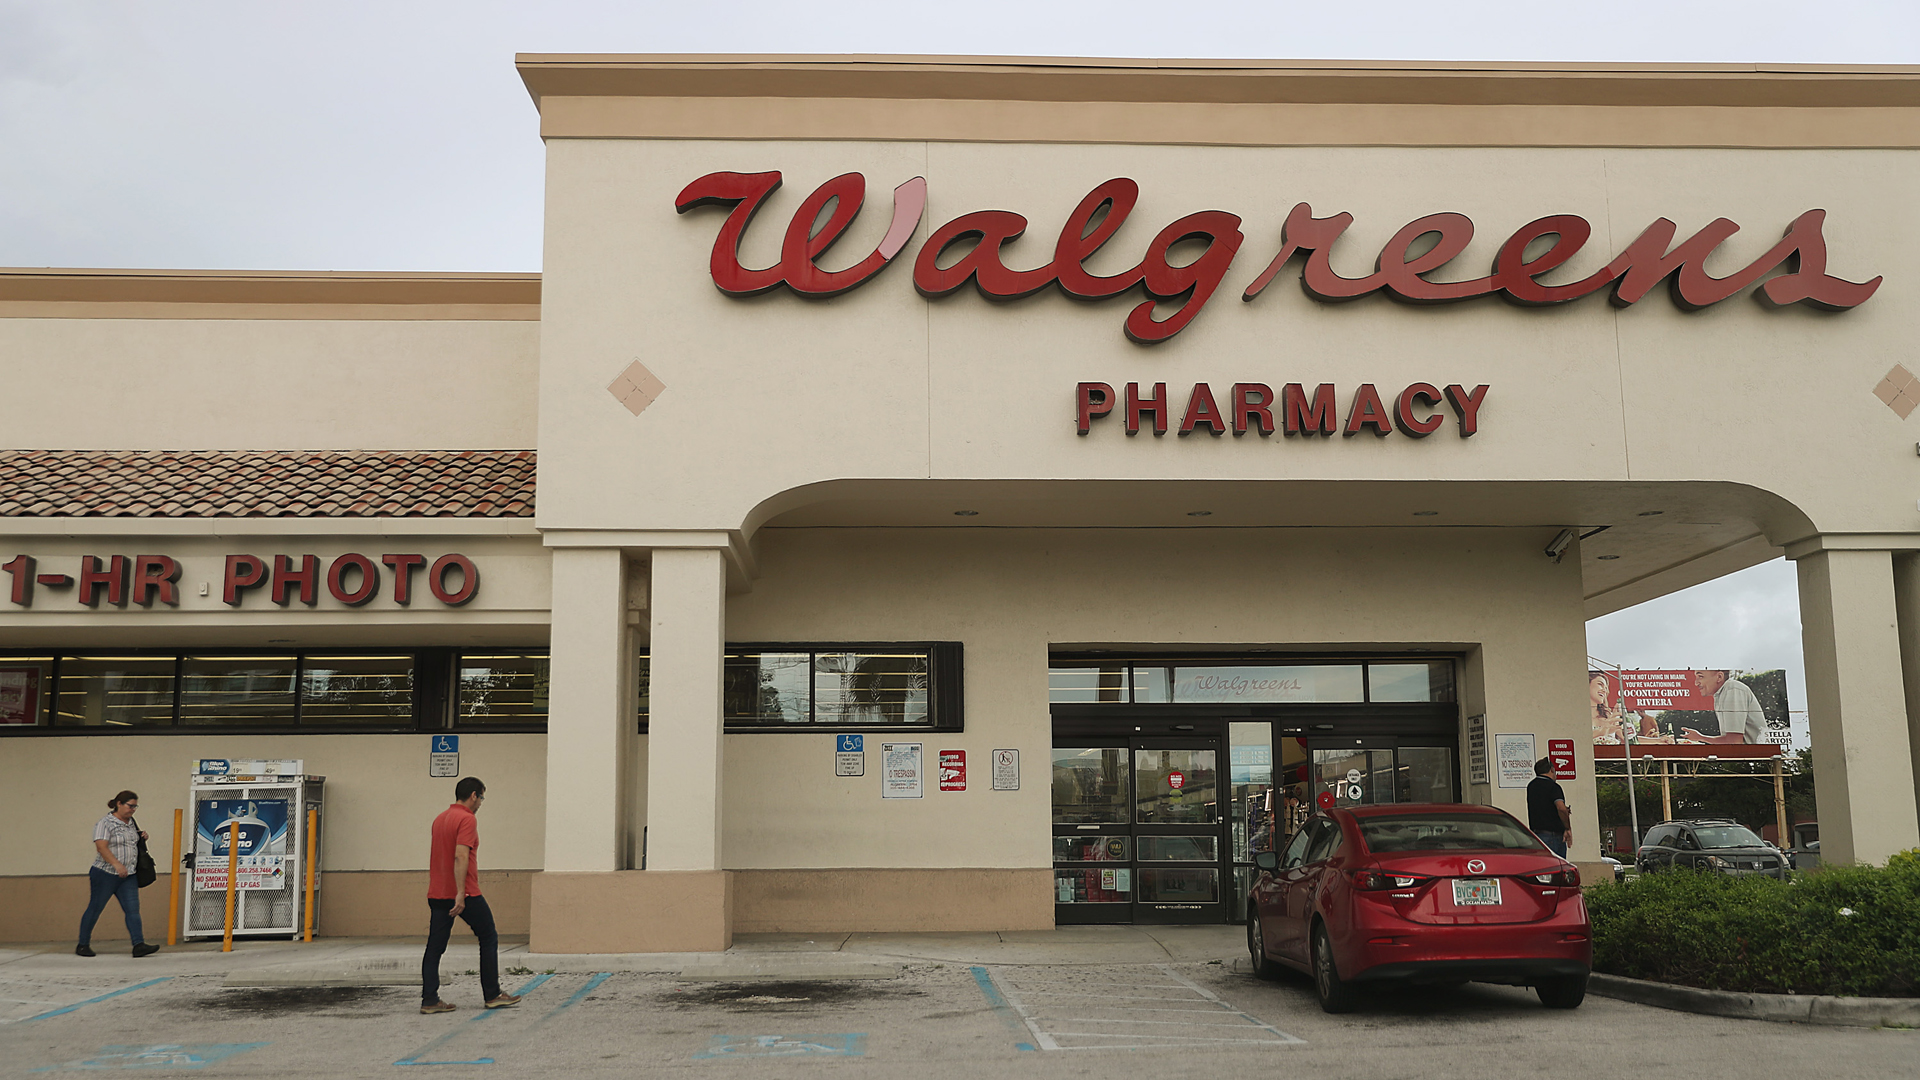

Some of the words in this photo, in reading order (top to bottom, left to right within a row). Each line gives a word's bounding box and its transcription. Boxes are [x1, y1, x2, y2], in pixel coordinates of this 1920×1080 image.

[675, 169, 1882, 345] Walgreens
[1076, 382, 1490, 437] PHARMACY
[2, 553, 183, 607] 1-HR
[222, 552, 480, 607] PHOTO
[1194, 675, 1302, 696] Walgreens
[1661, 689, 1690, 697] GROVE
[1636, 698, 1673, 706] RIVIERA
[1501, 760, 1508, 768] NO
[1508, 760, 1533, 768] TRESPASSING
[893, 769, 916, 778] TRESPASSIN
